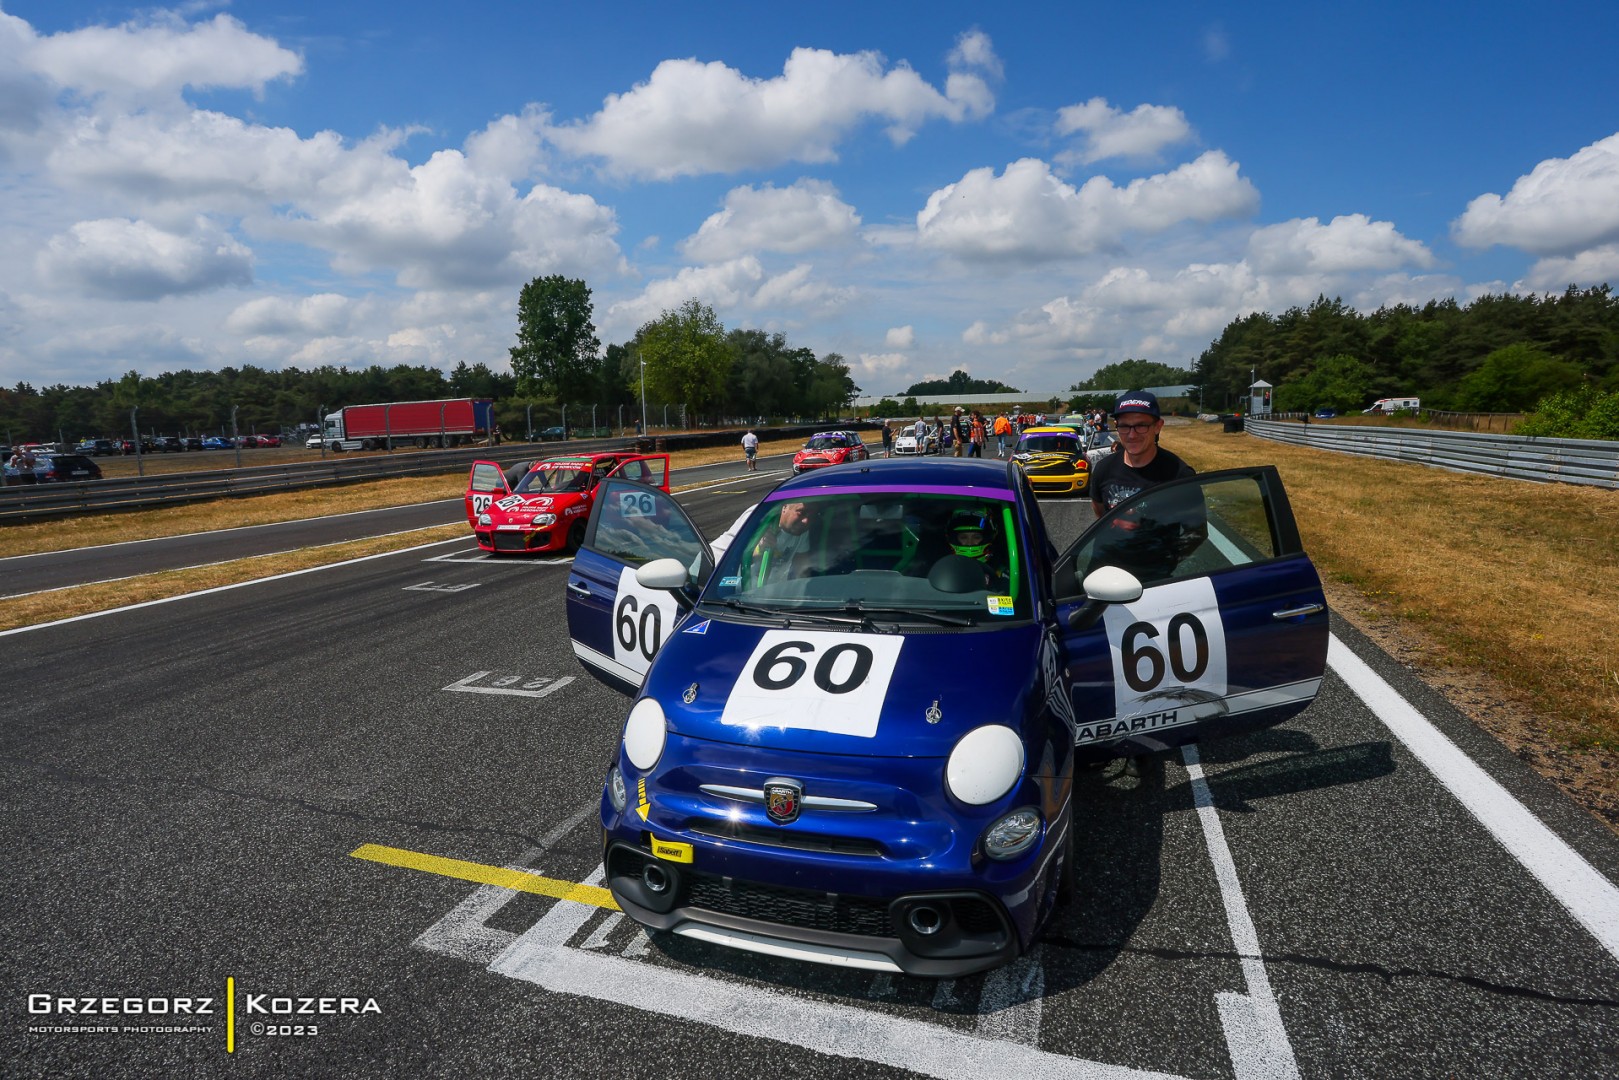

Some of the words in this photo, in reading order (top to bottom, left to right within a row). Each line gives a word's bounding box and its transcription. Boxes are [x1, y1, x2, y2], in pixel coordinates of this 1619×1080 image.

[1119, 399, 1151, 409] FEDERAL
[474, 496, 490, 514] 26
[623, 493, 652, 514] 26
[616, 595, 661, 663] 60
[1121, 612, 1209, 692] 60
[753, 641, 874, 694] 60
[1077, 711, 1177, 741] ABARTH
